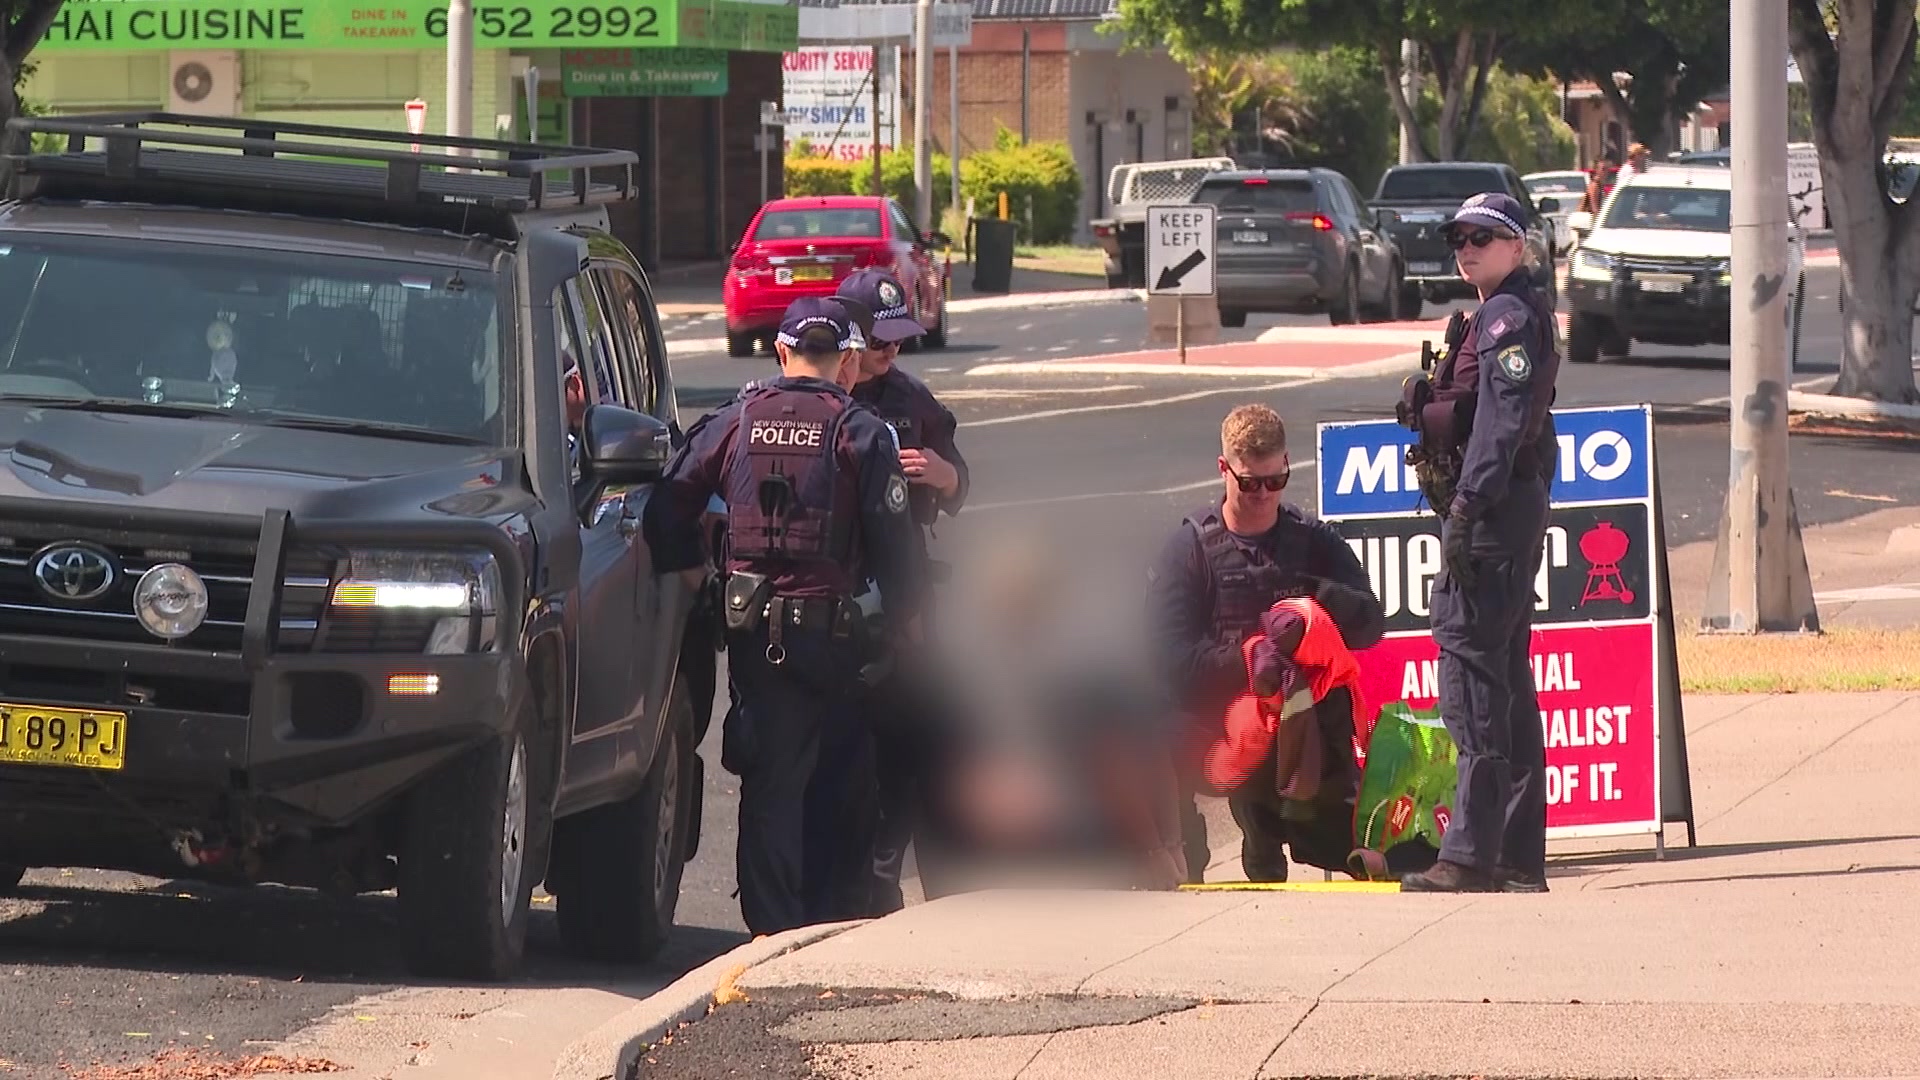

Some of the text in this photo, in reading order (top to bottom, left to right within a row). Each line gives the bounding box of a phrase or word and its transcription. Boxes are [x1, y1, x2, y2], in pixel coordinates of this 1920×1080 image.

[351, 9, 408, 21] DINE IN
[424, 7, 534, 38] 652
[548, 6, 660, 38] 2992
[43, 9, 305, 41] HAI CUISINE
[343, 26, 417, 38] TAKEAWAY
[782, 51, 875, 71] CURITY SERVI
[572, 70, 607, 83] Dine
[646, 69, 719, 82] Takeaway
[1160, 213, 1204, 228] KEEP
[1161, 232, 1201, 247] LEFT
[752, 420, 823, 430] NEW SOUTH WALES
[750, 427, 822, 447] POLICE
[1556, 430, 1632, 481] 10
[1540, 705, 1632, 748] IALIST
[63, 752, 99, 765] WALES
[1545, 762, 1622, 806] OF IT.
